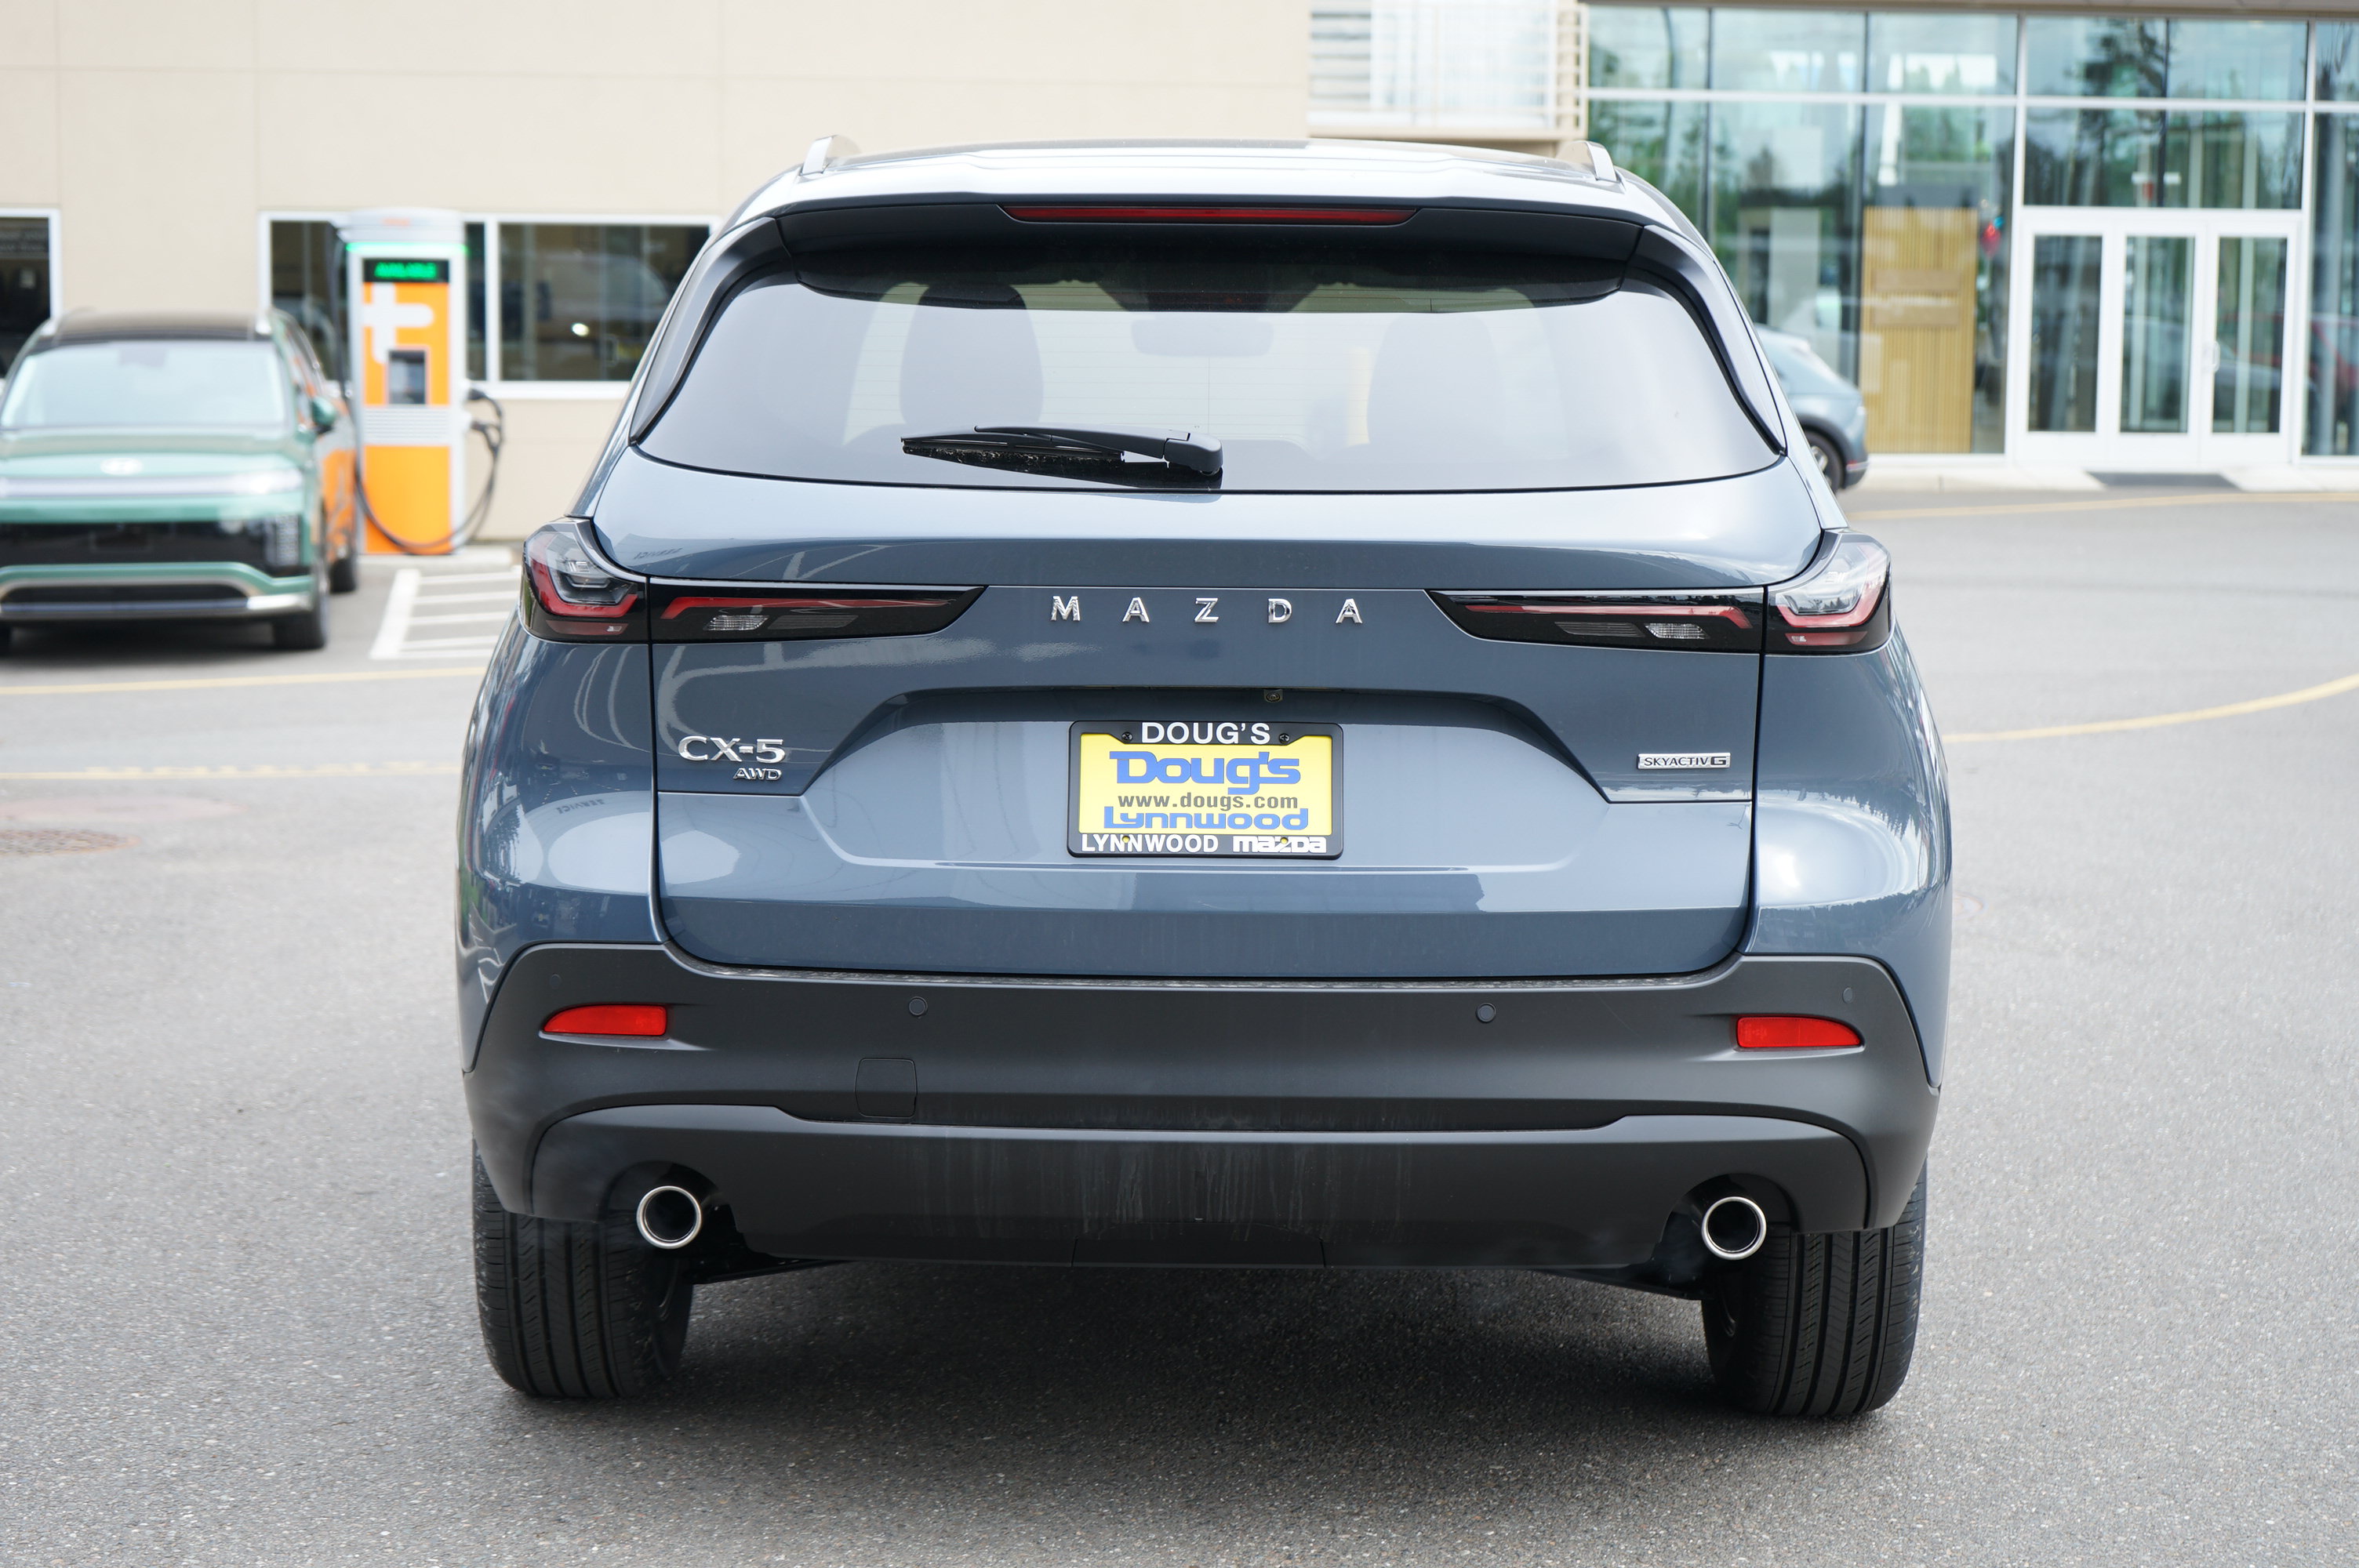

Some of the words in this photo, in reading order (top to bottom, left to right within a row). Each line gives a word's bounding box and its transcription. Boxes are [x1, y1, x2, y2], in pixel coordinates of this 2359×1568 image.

[1050, 595, 1363, 624] MAZDA
[1141, 721, 1270, 745] DOUG'S
[678, 735, 786, 764] CX-5
[732, 768, 782, 781] AWD
[1109, 750, 1301, 795] Doug's
[1118, 792, 1299, 811] www.dougs.com
[1103, 806, 1309, 830] Lynnwood
[1081, 833, 1219, 853] LYNNWOOD
